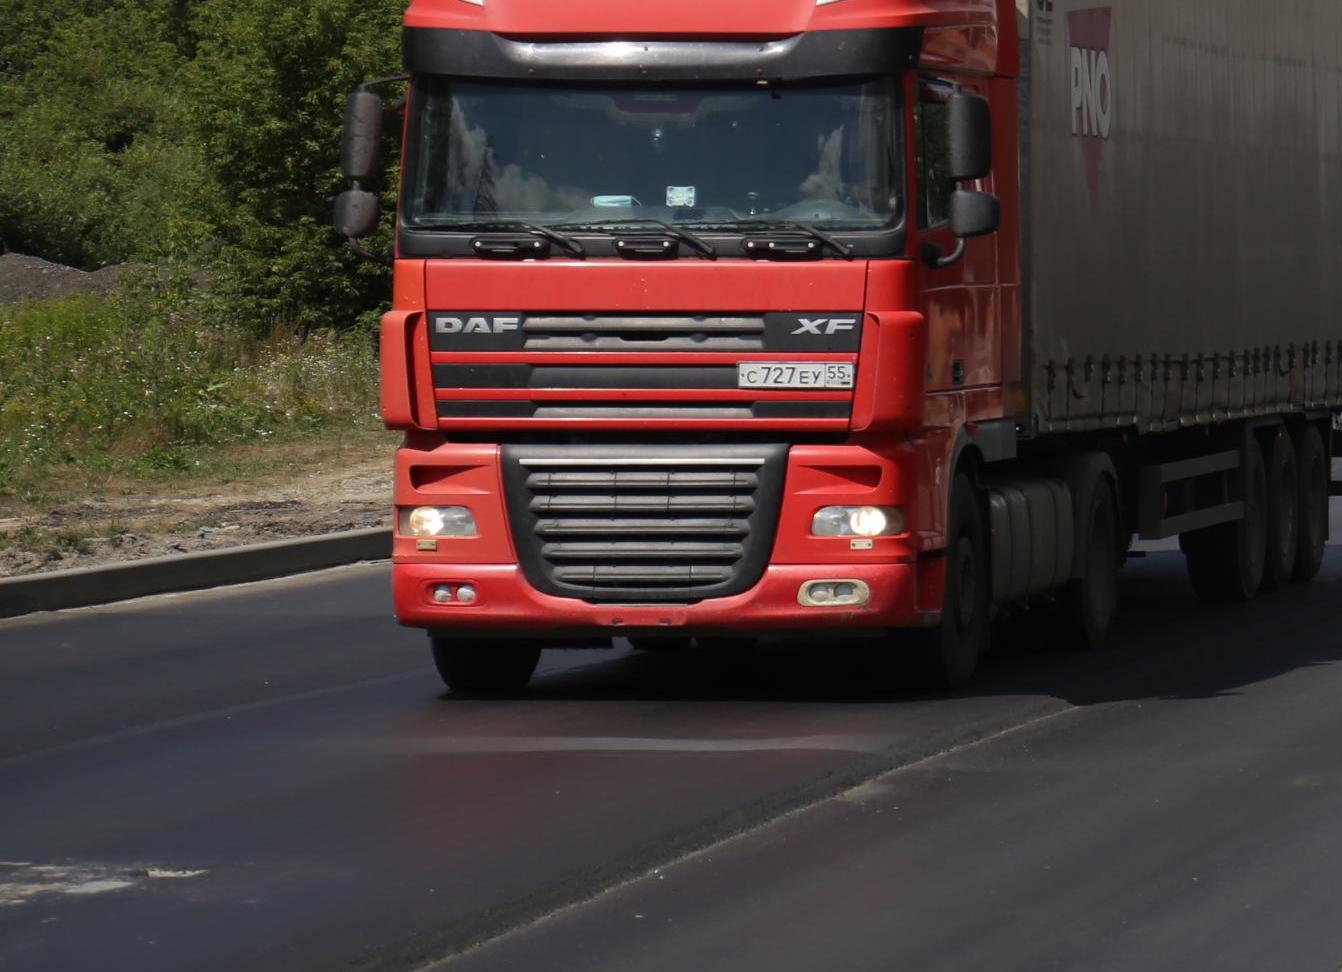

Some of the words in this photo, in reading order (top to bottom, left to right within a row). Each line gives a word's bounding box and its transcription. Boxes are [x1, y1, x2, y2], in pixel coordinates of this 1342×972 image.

[1070, 46, 1112, 139] PNO
[435, 316, 519, 334] DAF
[791, 317, 857, 335] XF
[827, 366, 846, 379] 55
